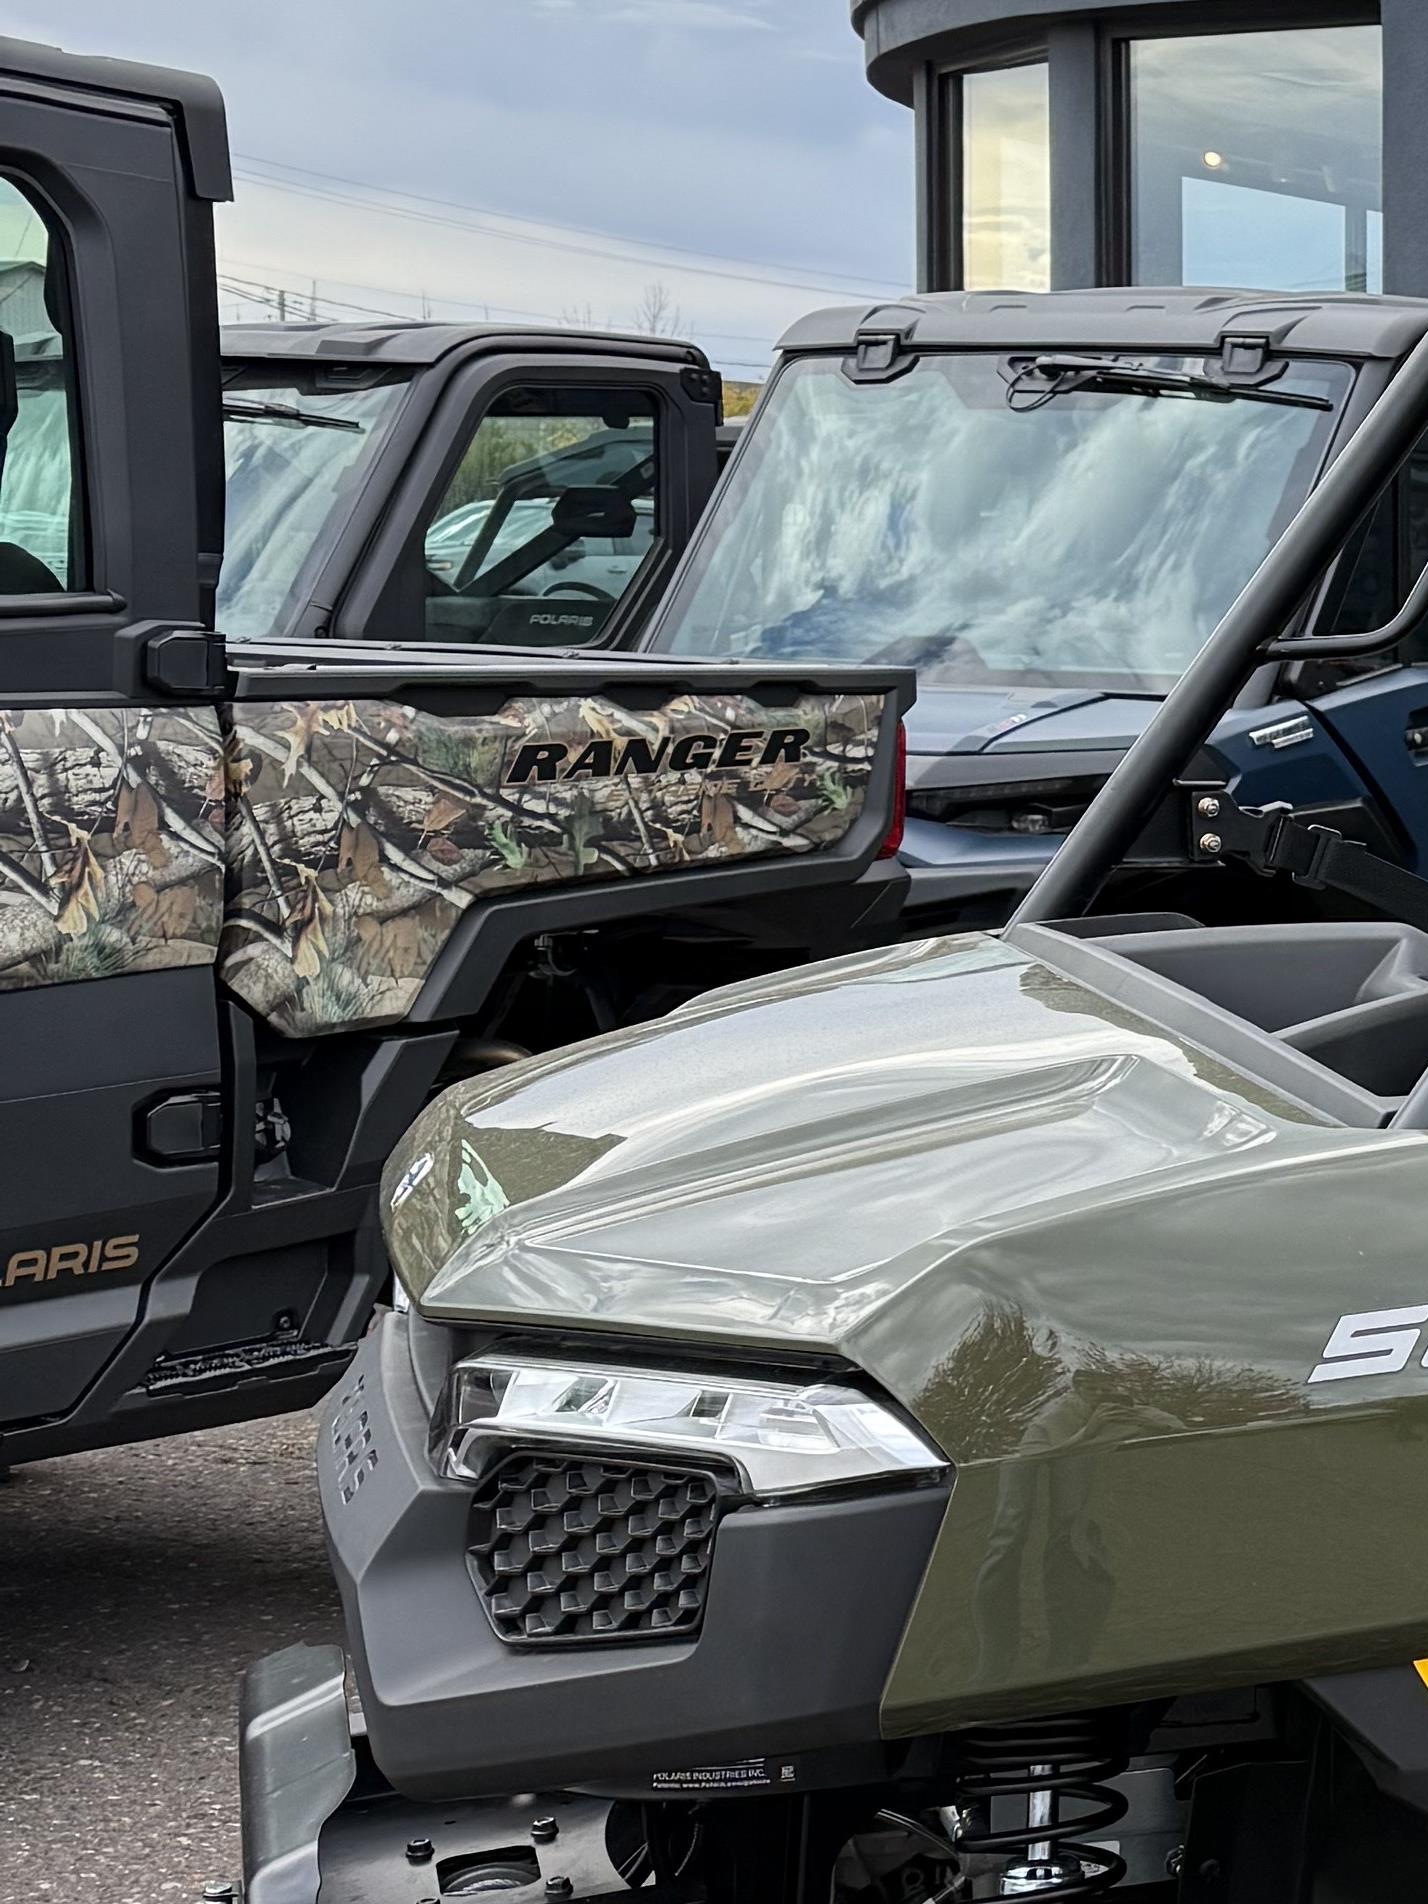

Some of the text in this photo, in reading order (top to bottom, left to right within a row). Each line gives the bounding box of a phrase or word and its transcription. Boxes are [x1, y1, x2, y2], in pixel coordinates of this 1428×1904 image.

[529, 614, 593, 627] POLARIS
[505, 727, 811, 784] RANGER
[0, 1234, 140, 1287] ARIS
